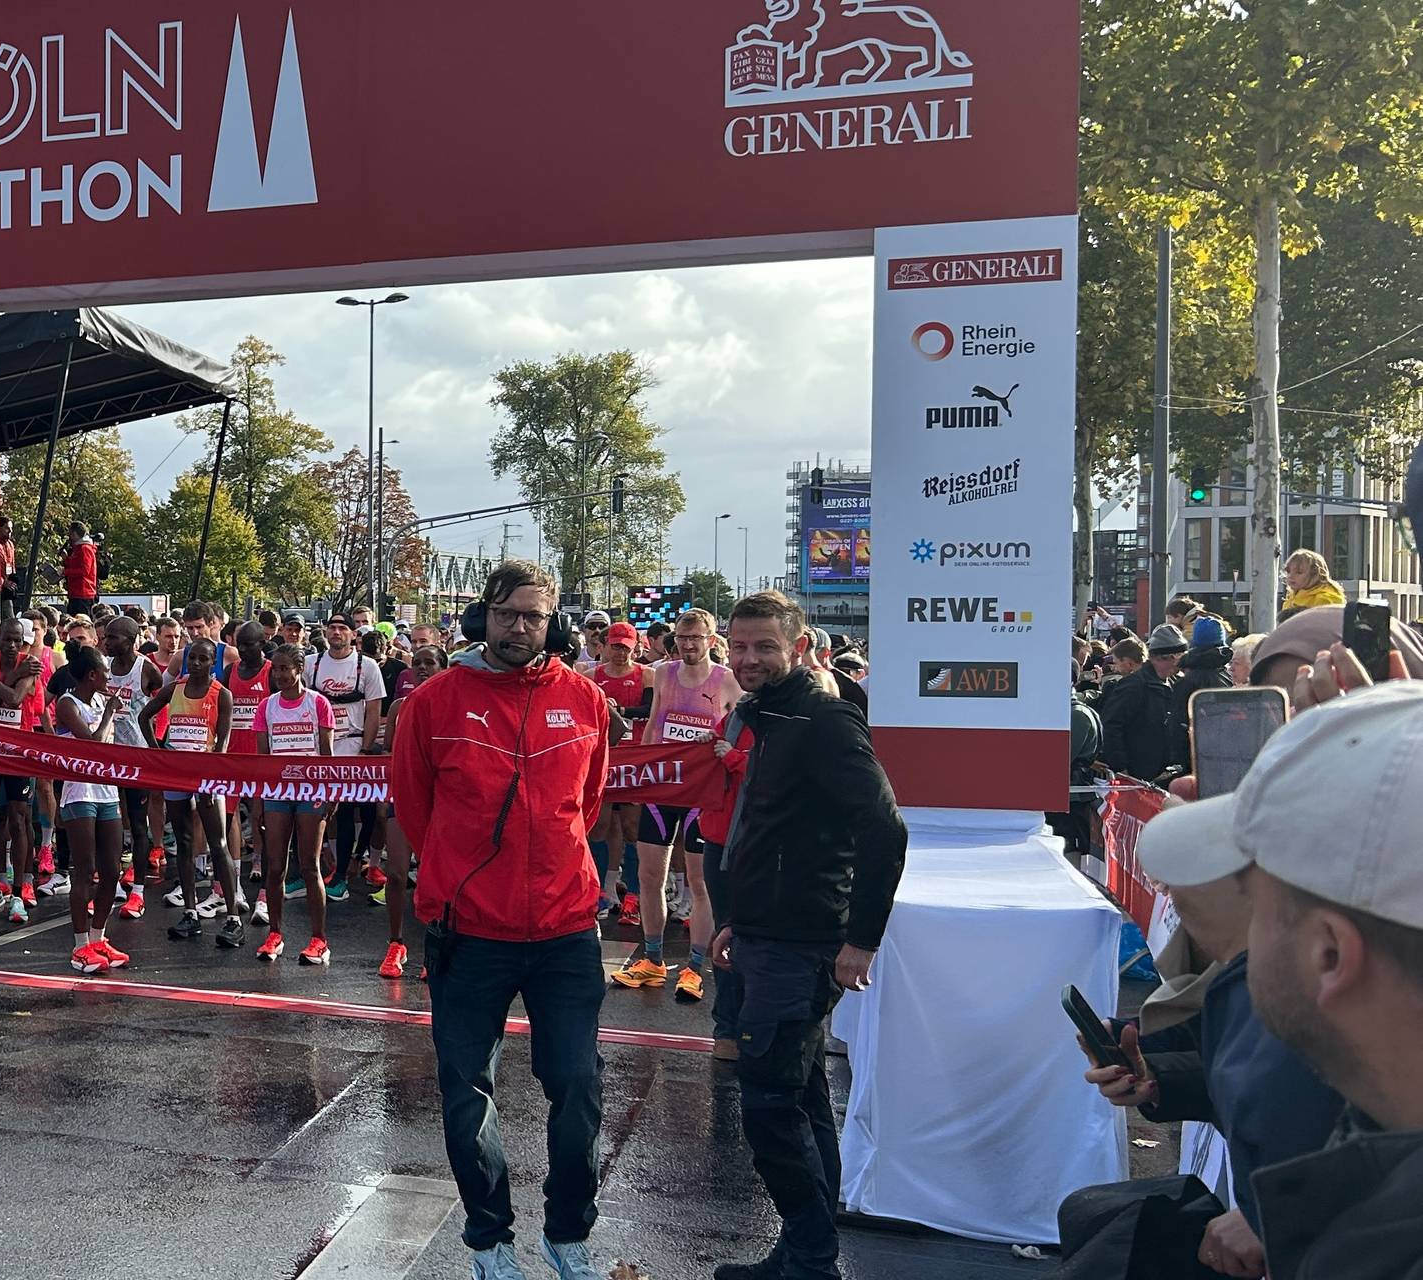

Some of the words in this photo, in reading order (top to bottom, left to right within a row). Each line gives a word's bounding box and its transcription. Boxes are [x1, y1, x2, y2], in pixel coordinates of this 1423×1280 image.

[723, 97, 973, 157] GENERALI
[931, 255, 1056, 282] GENERALI
[962, 323, 1016, 341] Rhein
[962, 339, 1035, 358] Energie
[926, 405, 999, 430] PUMA
[921, 458, 1021, 499] Reissdorf
[822, 497, 858, 509] LANXESS
[859, 497, 871, 508] ar
[948, 479, 1019, 506] ALKOHOLFREI
[939, 541, 1031, 567] pixum
[906, 597, 999, 623] REWE
[991, 625, 1033, 633] GROUP
[956, 668, 1010, 692] AWB
[281, 722, 313, 732] GENERALI
[675, 713, 712, 726] GENERALI
[169, 727, 207, 735] CHEPKOECH
[23, 748, 142, 781] GENERALI
[306, 764, 387, 780] GENERALI
[260, 782, 388, 803] MARATHON
